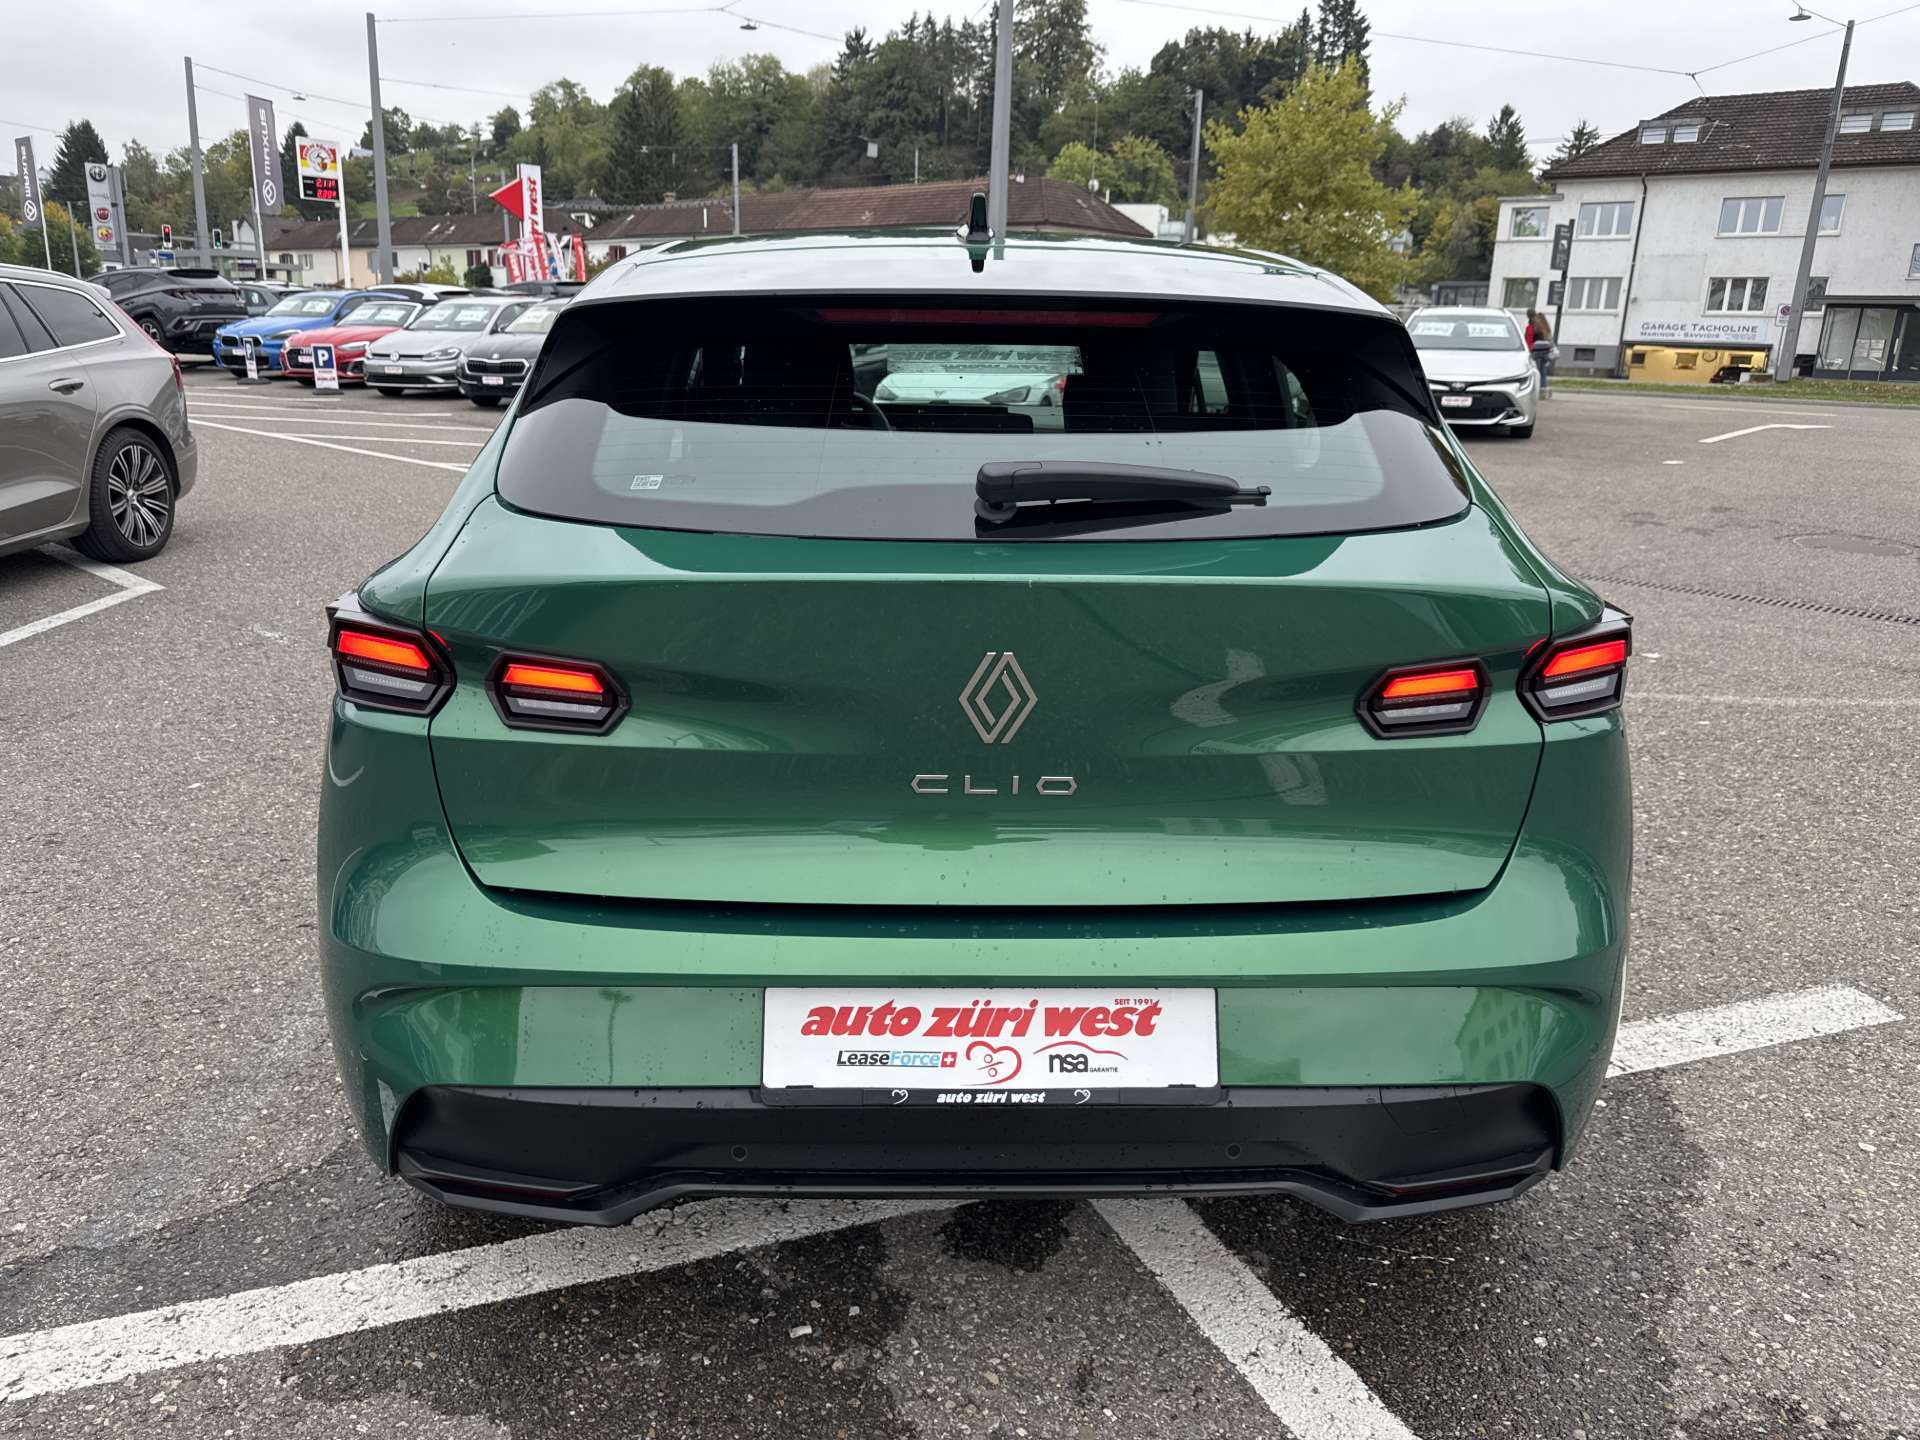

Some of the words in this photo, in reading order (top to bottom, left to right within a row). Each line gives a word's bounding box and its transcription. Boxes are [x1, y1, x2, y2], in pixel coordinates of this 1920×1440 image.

[1641, 321, 1687, 332] GARAGE
[1691, 323, 1759, 334] TACHOLINE
[245, 343, 252, 358] P
[317, 349, 329, 367] P
[911, 775, 1078, 796] CLIO
[1114, 998, 1130, 1006] SEIT
[1133, 998, 1153, 1006] 1991
[800, 999, 922, 1037] auto
[922, 999, 1039, 1037] züri
[1044, 999, 1163, 1037] west
[836, 1050, 941, 1066] LeaseForce
[1049, 1053, 1089, 1073] nsa
[936, 1091, 972, 1104] auto
[974, 1091, 1007, 1104] züri
[1009, 1091, 1046, 1104] west
